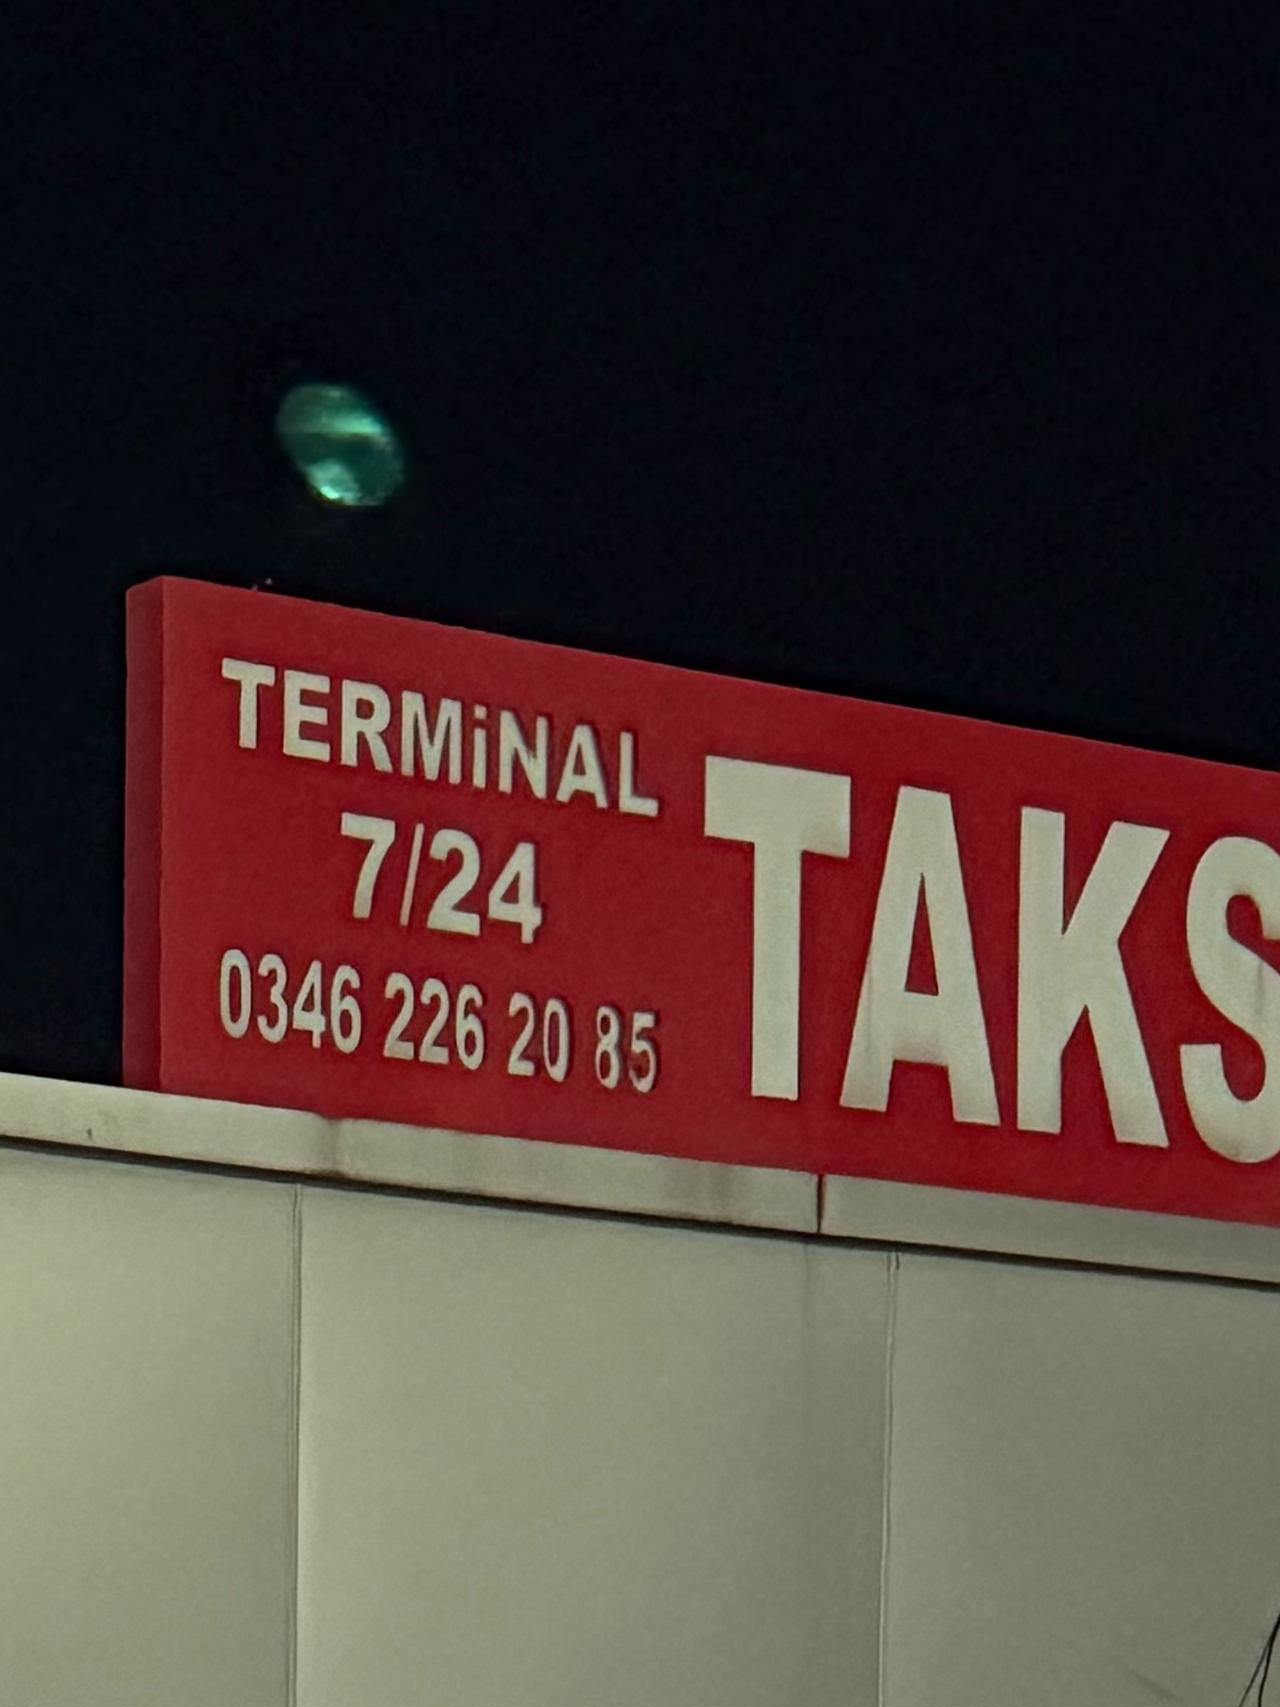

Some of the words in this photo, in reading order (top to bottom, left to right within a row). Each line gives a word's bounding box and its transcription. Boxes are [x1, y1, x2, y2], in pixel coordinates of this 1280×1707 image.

[341, 811, 543, 944] 7/24
[220, 948, 362, 1054] 0346
[384, 972, 485, 1071] 226
[507, 992, 570, 1083] 20
[595, 1005, 658, 1093] 85
